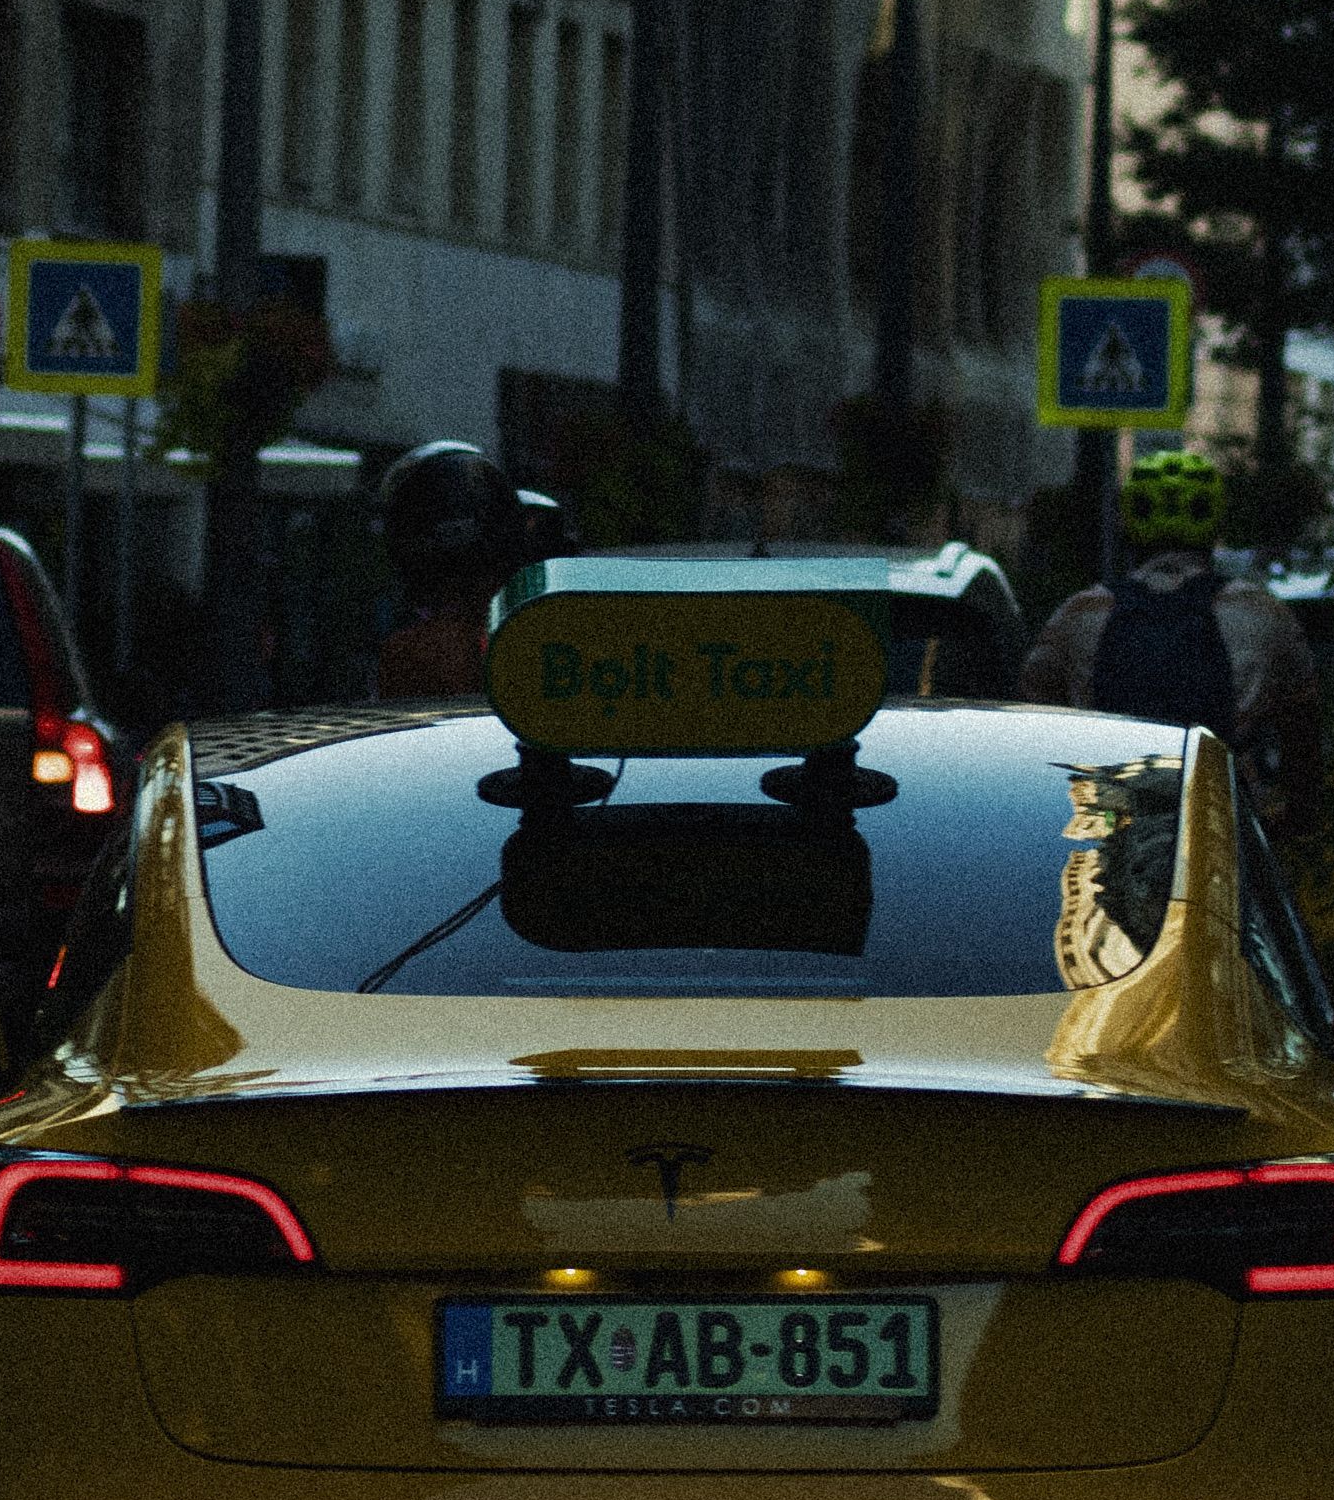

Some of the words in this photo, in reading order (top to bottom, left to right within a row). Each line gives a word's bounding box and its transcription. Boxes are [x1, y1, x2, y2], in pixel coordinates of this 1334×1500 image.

[542, 642, 675, 716] Bolt
[696, 641, 836, 701] Taxi
[456, 1358, 479, 1385] H
[584, 1397, 792, 1417] TESLA.COM
